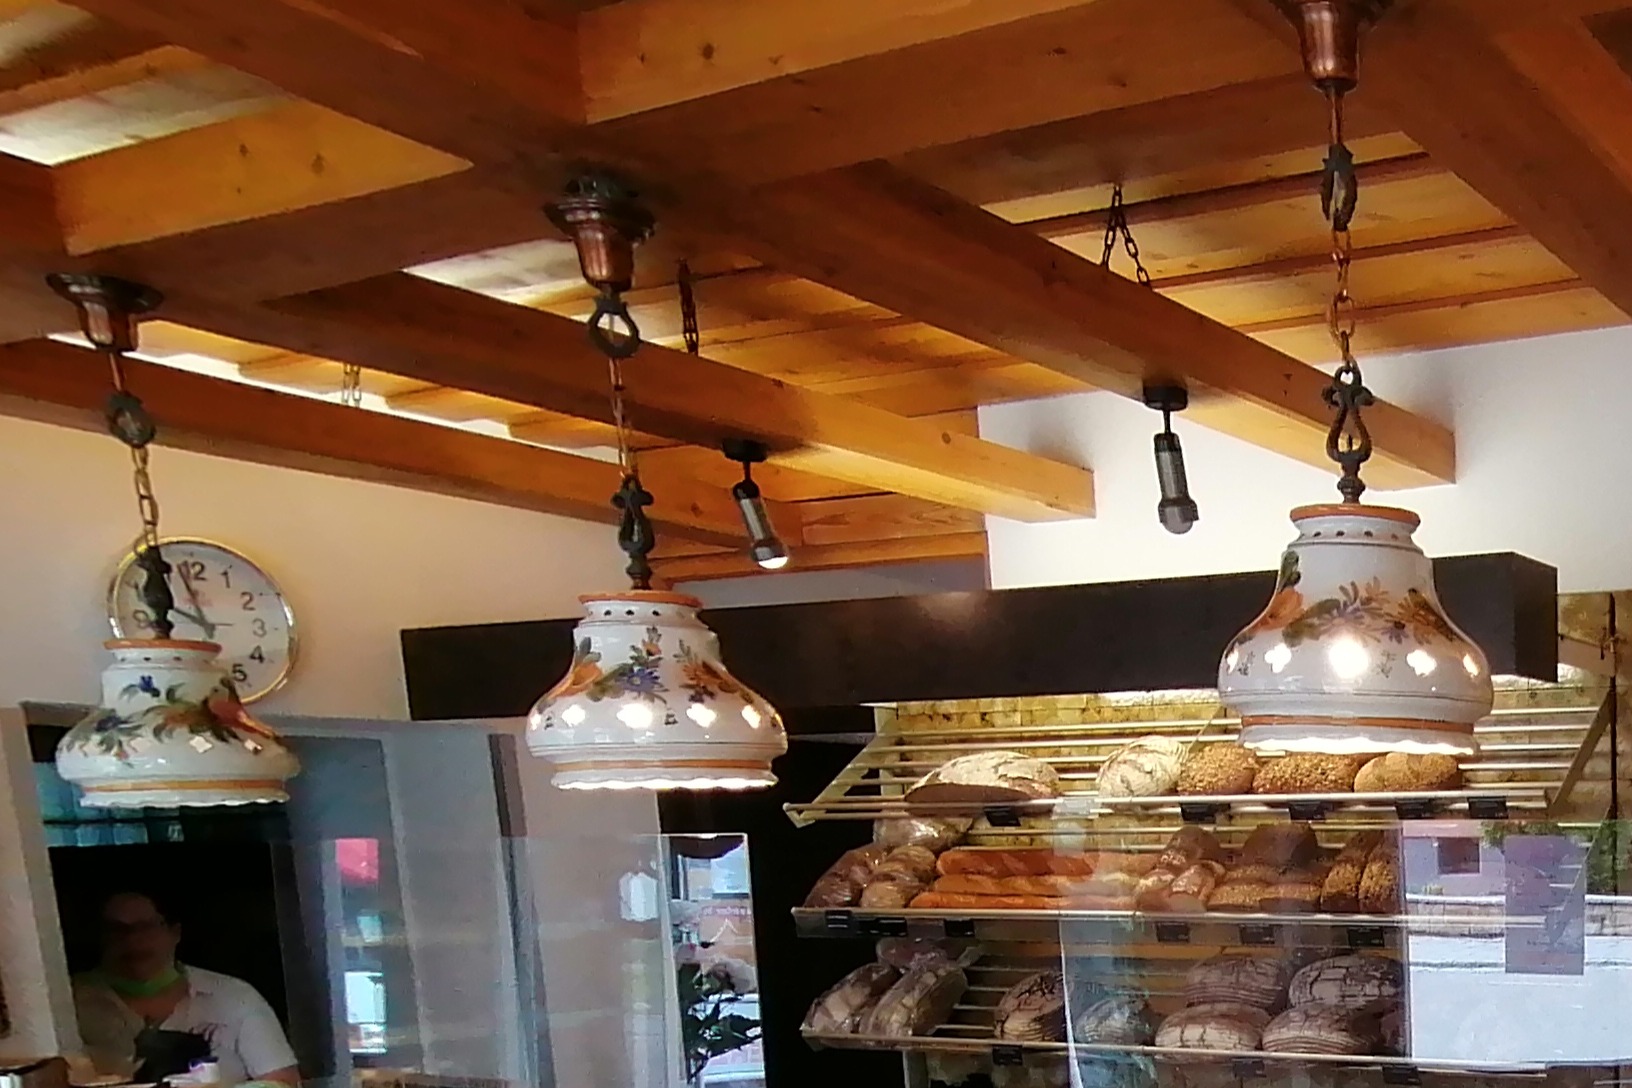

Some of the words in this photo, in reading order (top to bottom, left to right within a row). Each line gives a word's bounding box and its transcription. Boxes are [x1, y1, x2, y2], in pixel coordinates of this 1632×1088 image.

[221, 569, 231, 589] 1
[240, 591, 256, 611] 2
[252, 618, 267, 638] 3
[249, 645, 265, 664] 4
[232, 664, 247, 682] 5
